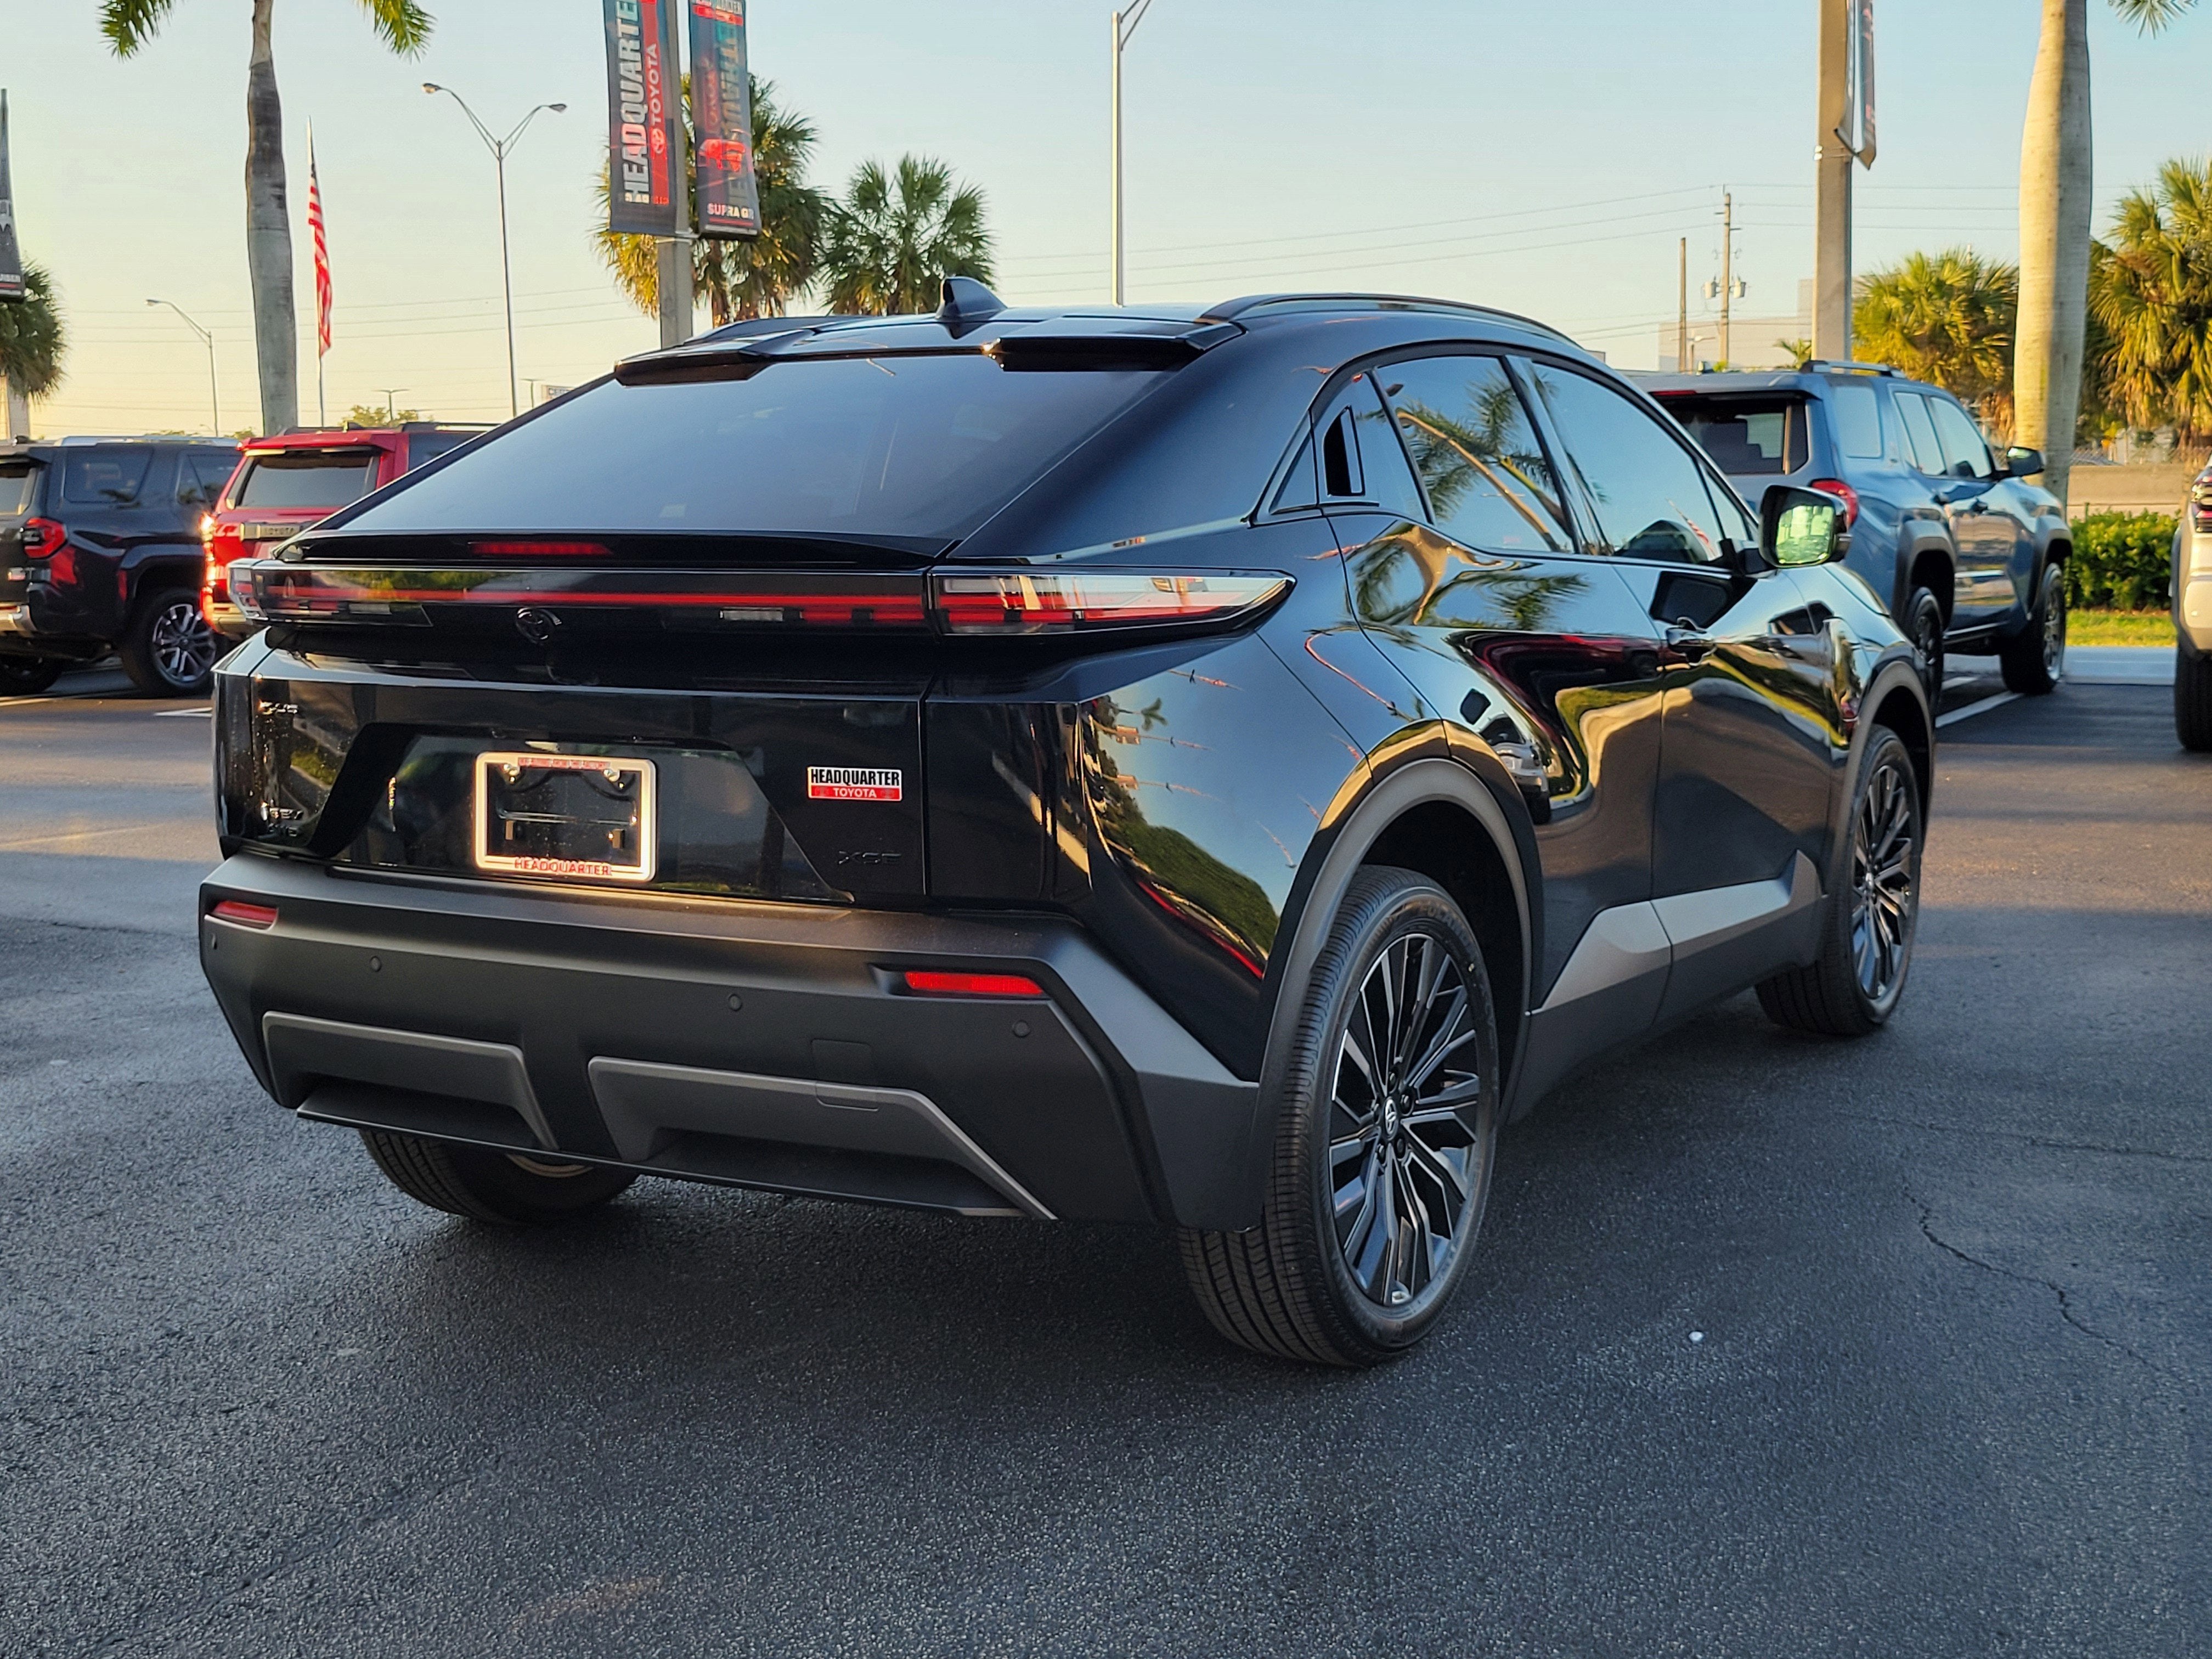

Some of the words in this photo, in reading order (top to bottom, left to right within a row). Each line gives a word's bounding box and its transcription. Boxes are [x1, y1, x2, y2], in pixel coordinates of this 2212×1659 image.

[646, 43, 663, 126] TOYOTA
[707, 202, 740, 218] SUPRA
[811, 769, 900, 786] HEADQUARTER
[833, 788, 877, 798] TOYOTA
[514, 857, 612, 876] HEADQUARTER
